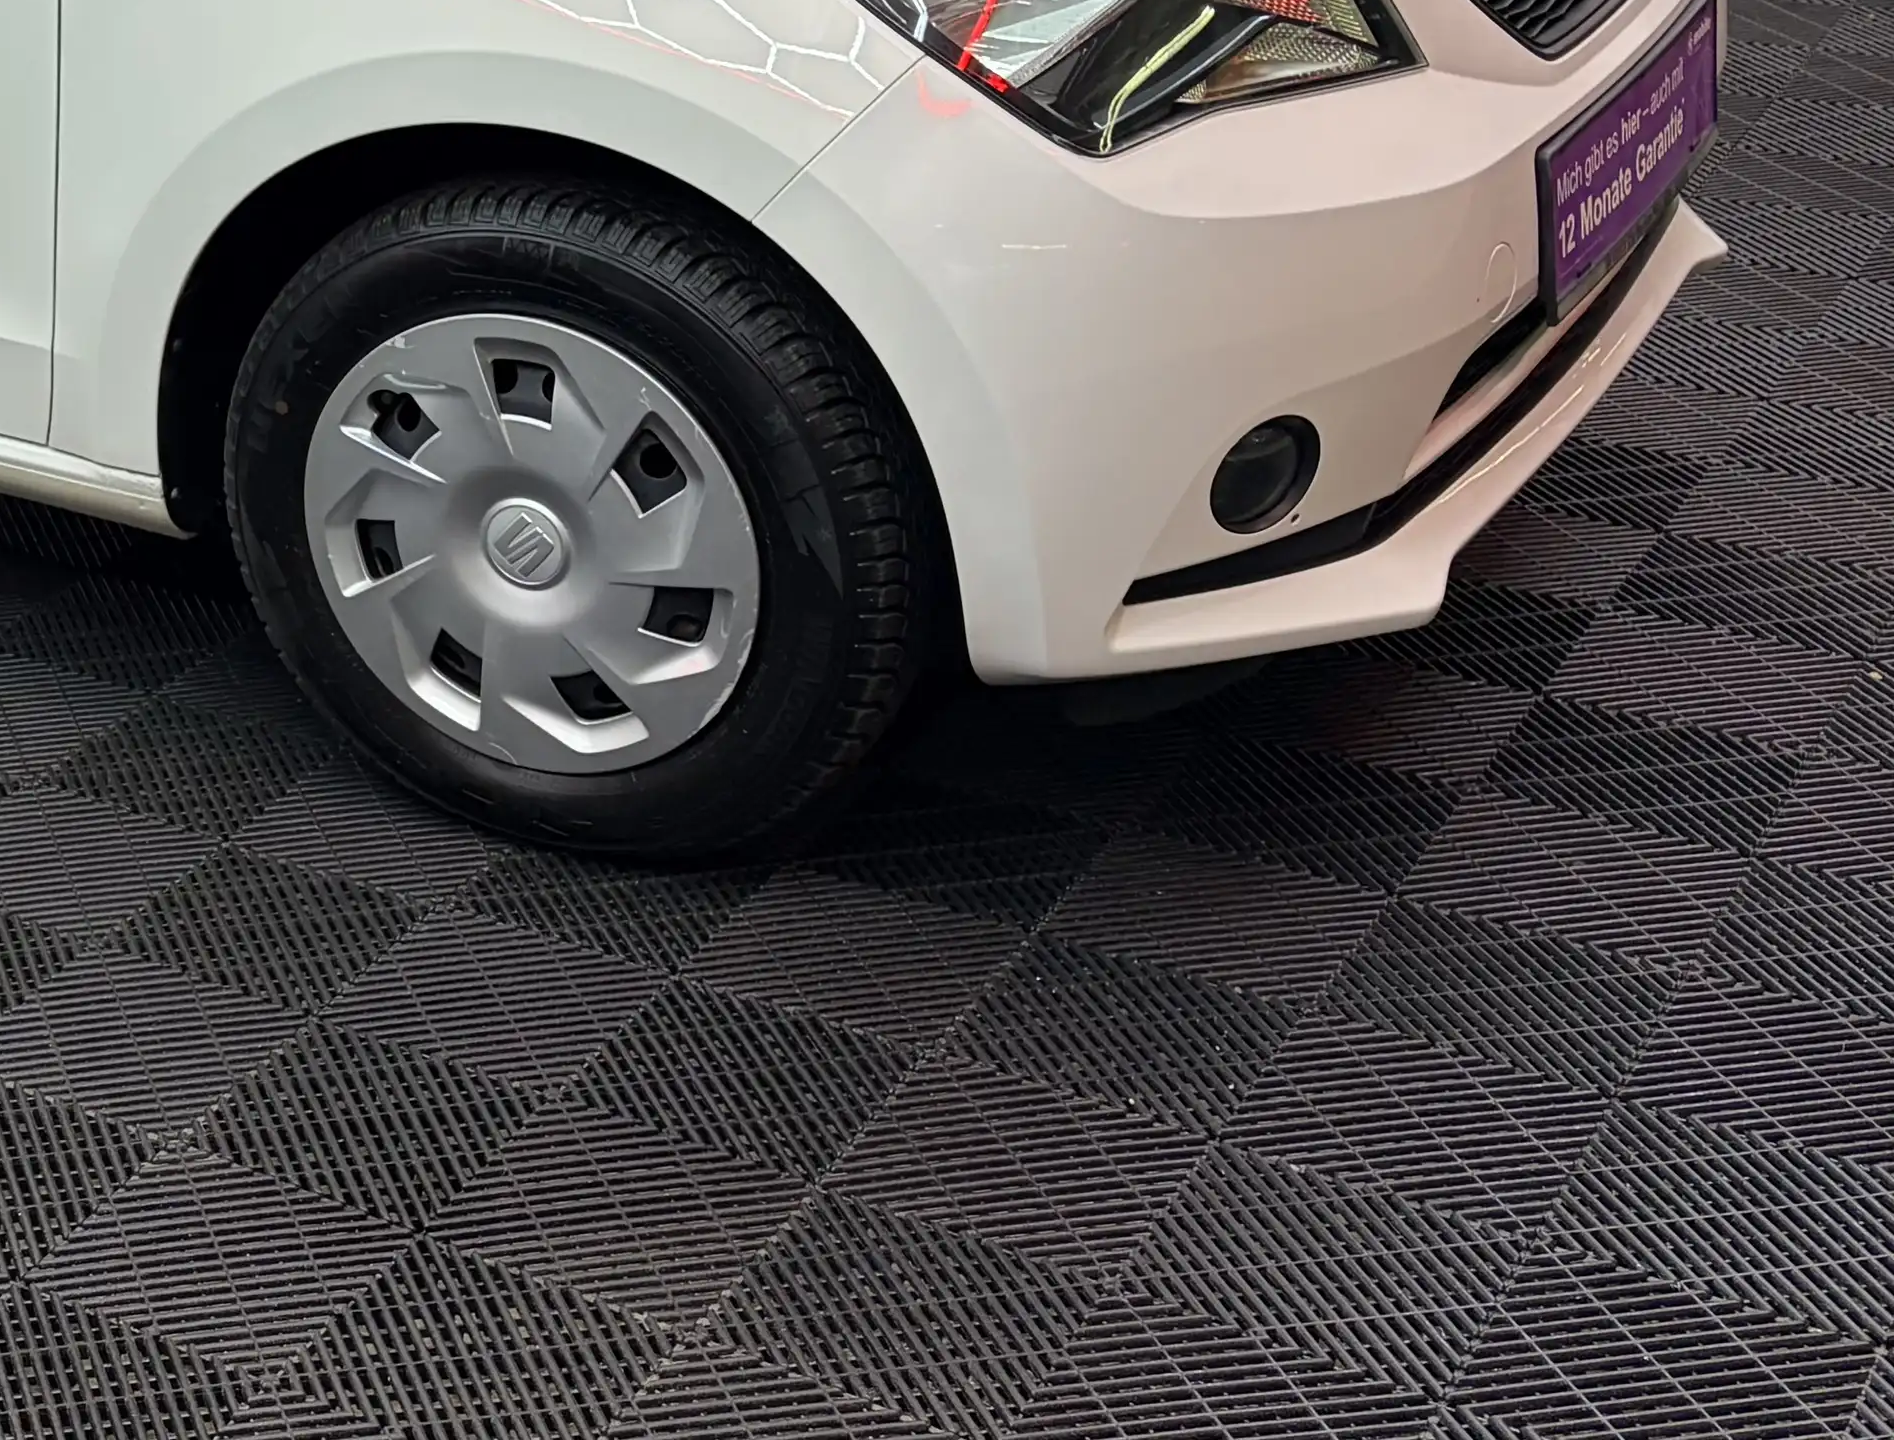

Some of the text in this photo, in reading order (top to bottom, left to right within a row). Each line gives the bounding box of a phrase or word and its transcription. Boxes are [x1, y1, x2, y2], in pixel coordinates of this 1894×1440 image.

[1557, 161, 1583, 207] Mich
[1584, 139, 1605, 187] gibt
[1606, 131, 1620, 159] es
[1621, 108, 1642, 145] hier
[1650, 73, 1671, 115] auch
[1671, 56, 1684, 91] mit
[1558, 213, 1576, 259] 12
[1580, 167, 1632, 240] Monate
